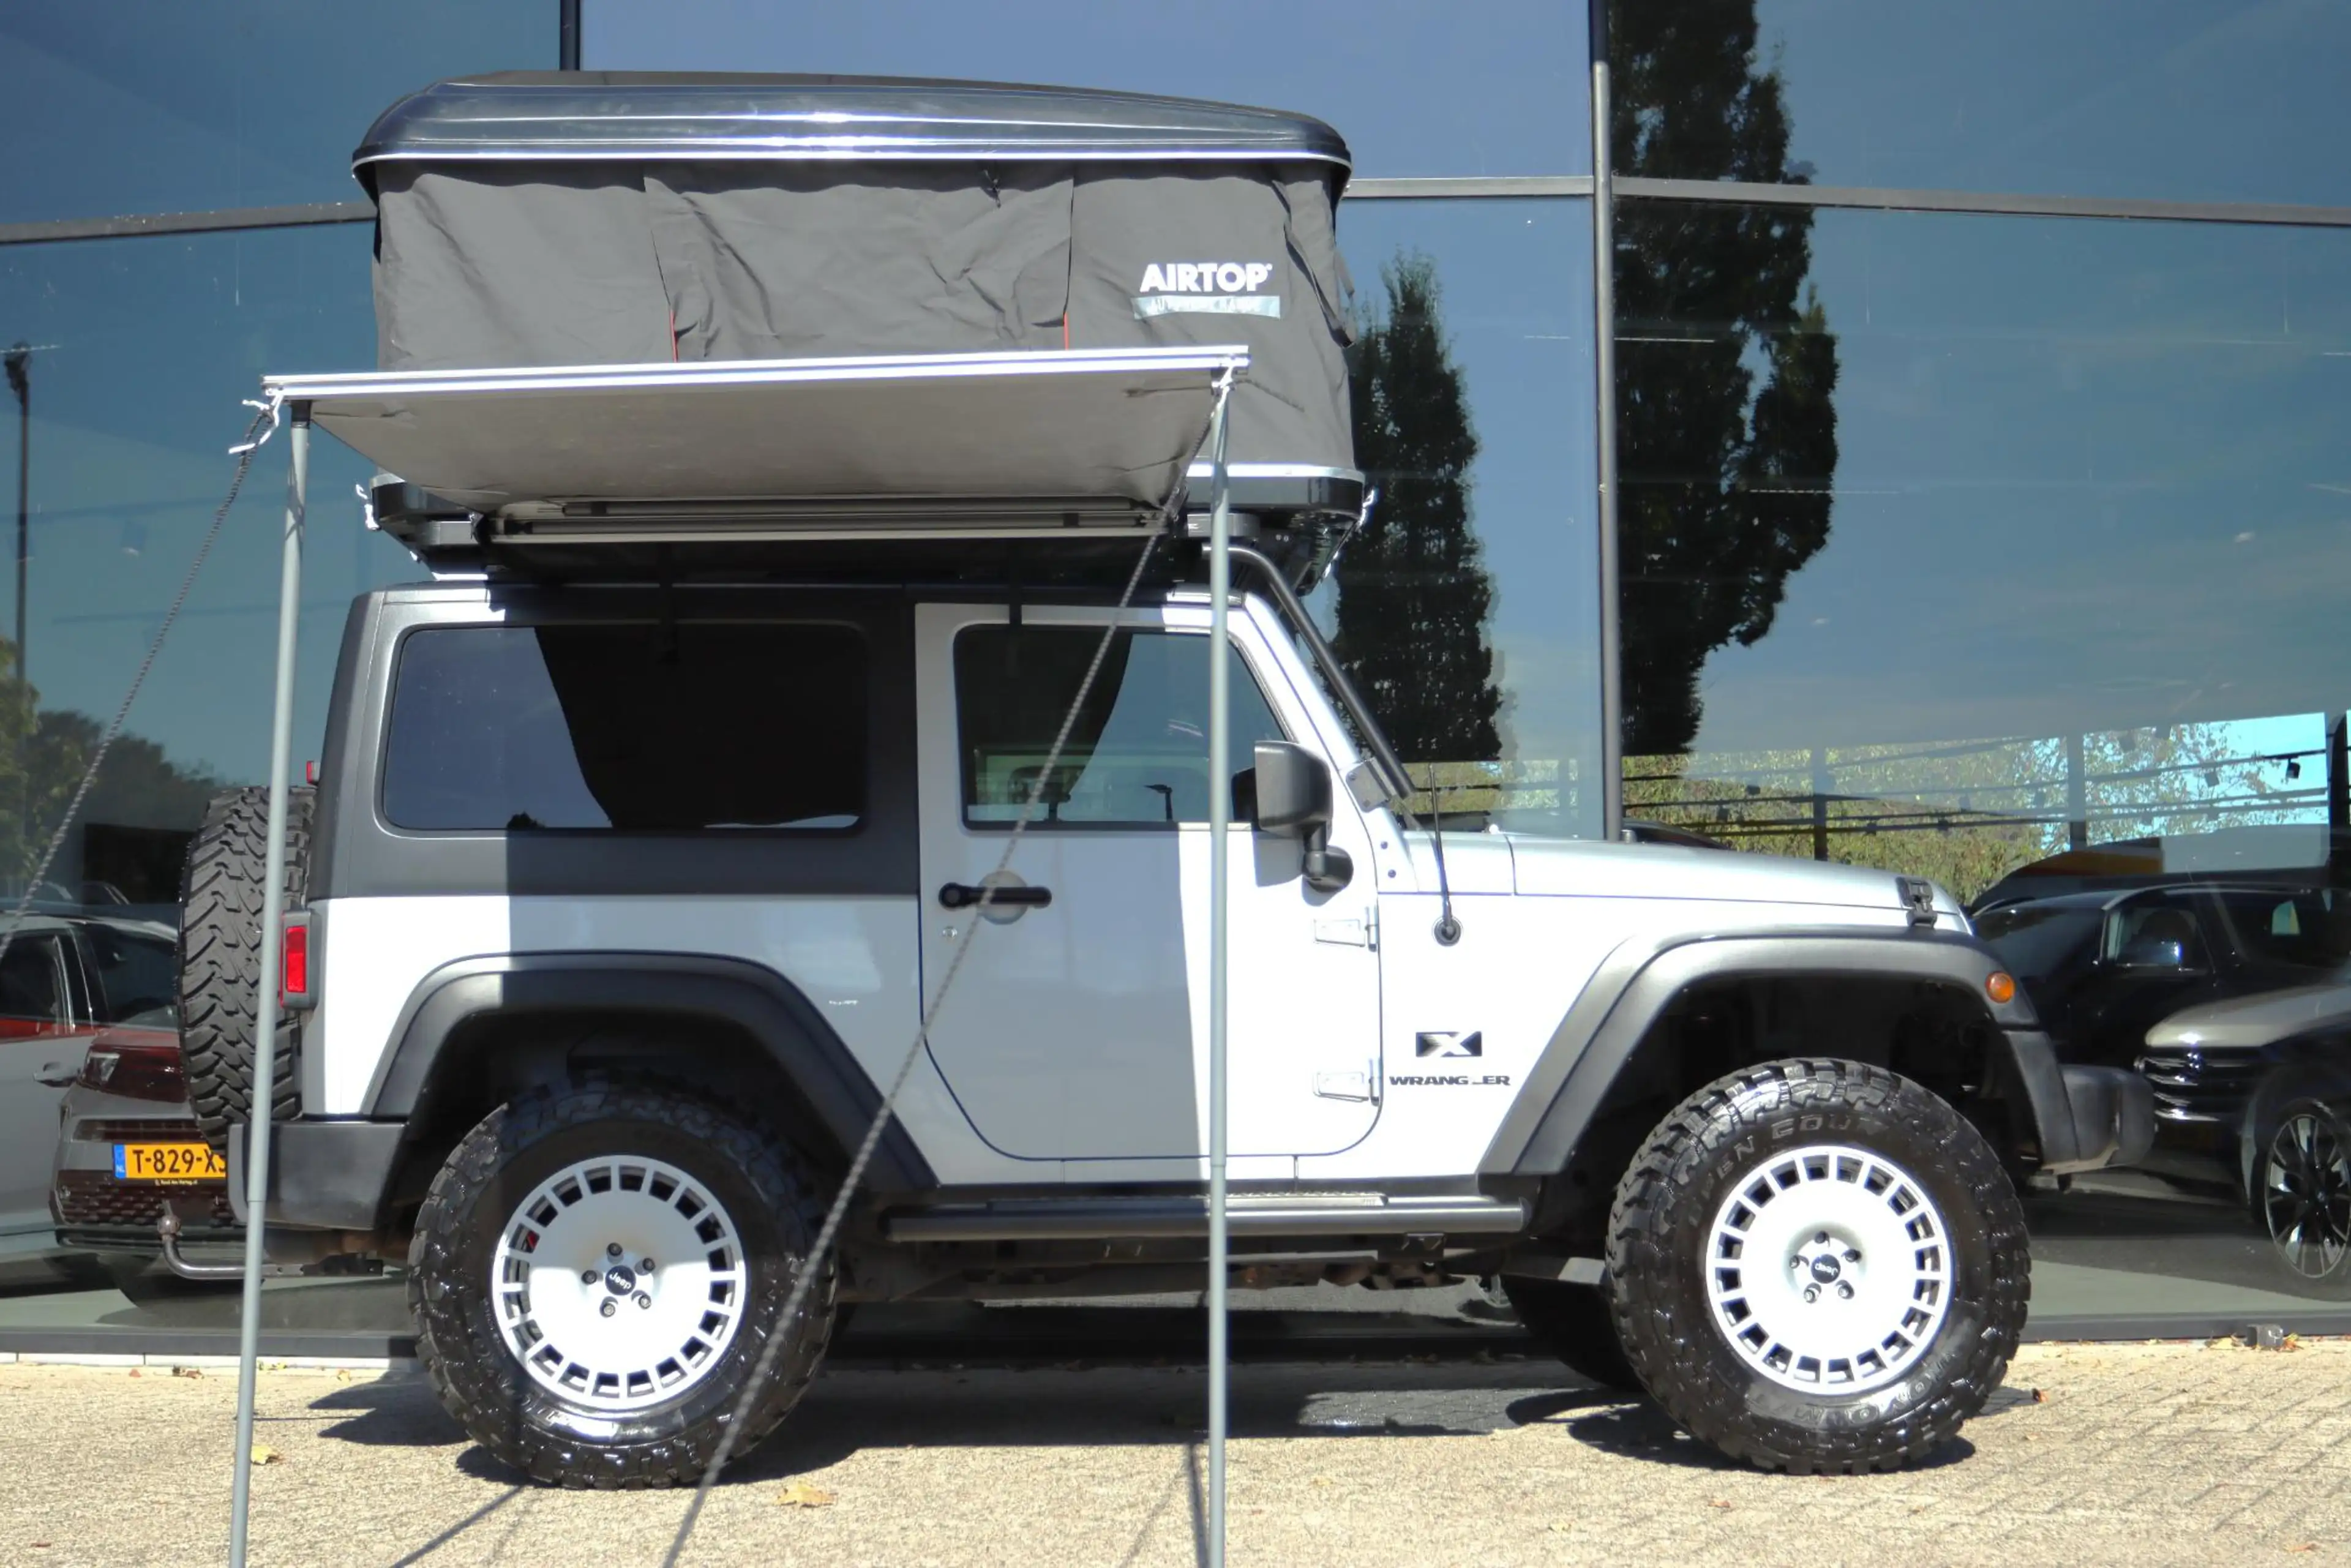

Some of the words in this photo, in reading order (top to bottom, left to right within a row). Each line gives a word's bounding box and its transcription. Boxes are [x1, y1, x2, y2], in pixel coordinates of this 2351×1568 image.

[1139, 263, 1269, 292] AIRTOP
[1814, 1262, 1839, 1278] Jeep
[609, 1272, 632, 1290] Jeep
